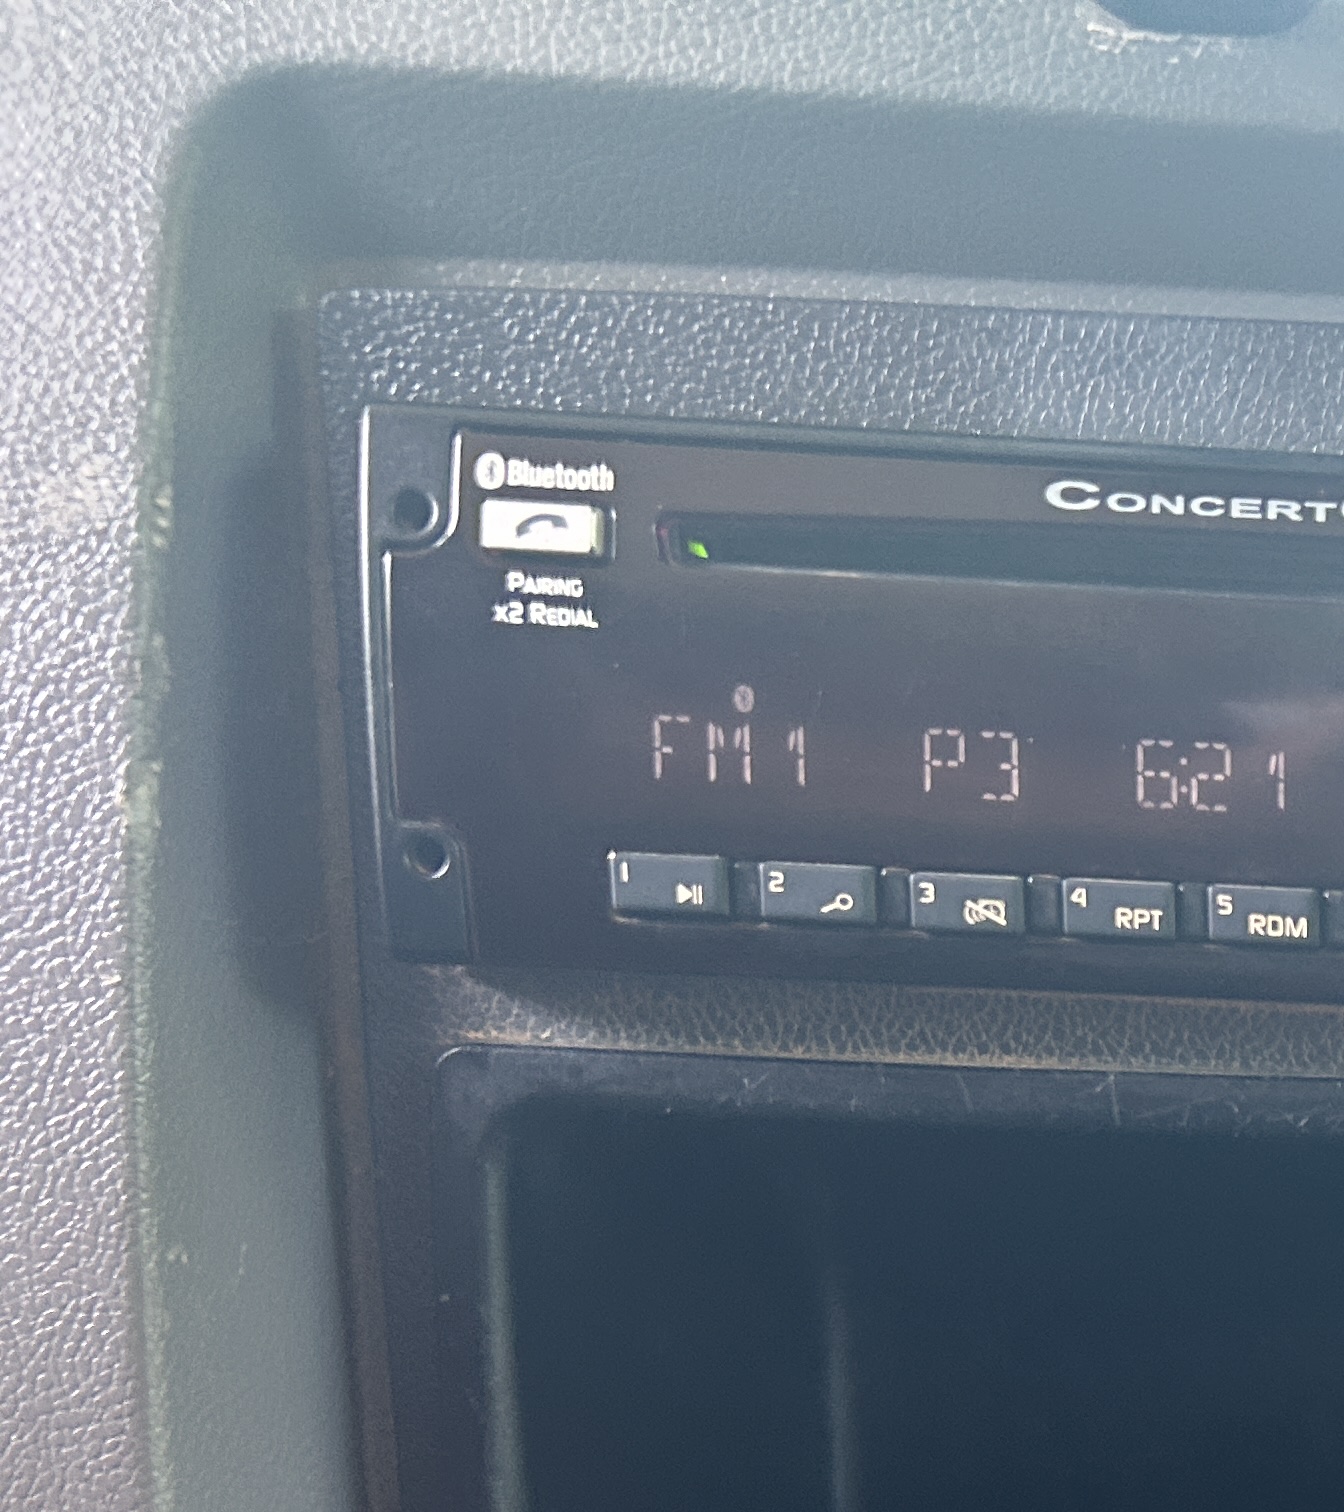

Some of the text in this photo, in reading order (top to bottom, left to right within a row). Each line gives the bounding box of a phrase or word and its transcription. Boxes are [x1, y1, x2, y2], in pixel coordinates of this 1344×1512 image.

[507, 459, 615, 492] Bluetooth
[923, 728, 1019, 801] P3
[1136, 739, 1285, 811] 6:21
[619, 862, 630, 883] 1
[768, 872, 785, 893] 2
[919, 882, 936, 904] 3
[1070, 887, 1164, 932] 4 RPT
[1216, 895, 1309, 939] 5 RDM
